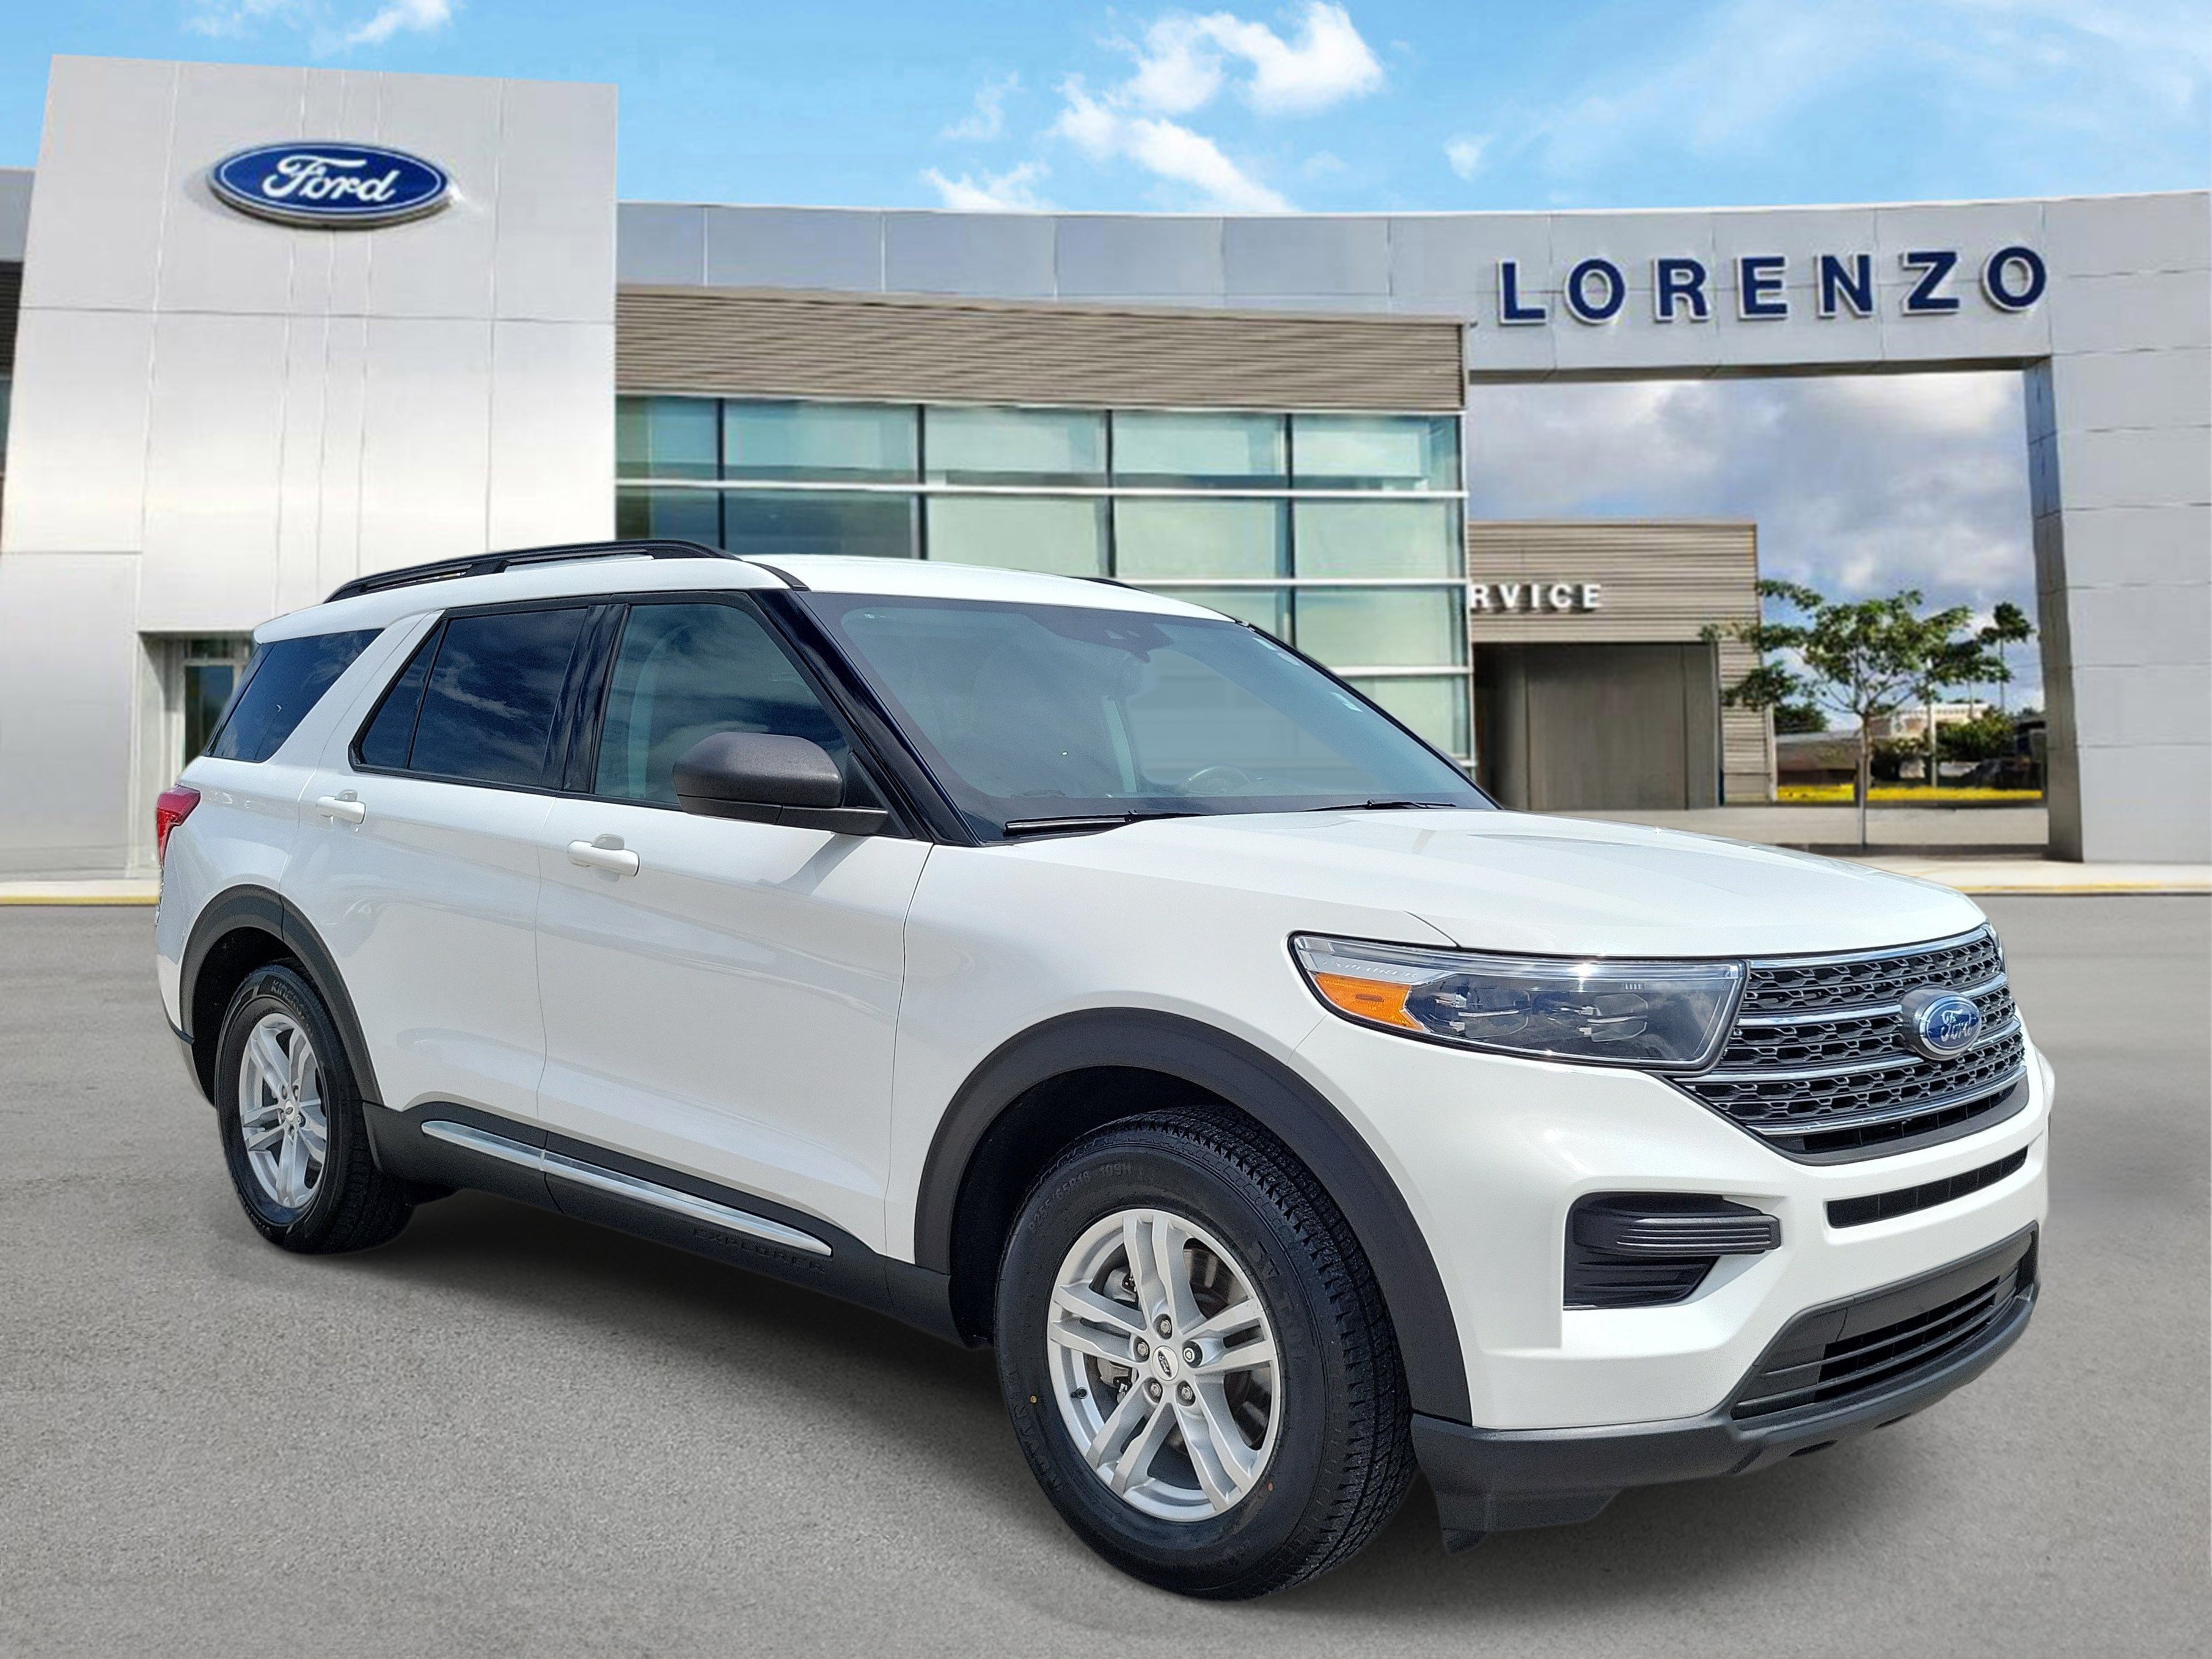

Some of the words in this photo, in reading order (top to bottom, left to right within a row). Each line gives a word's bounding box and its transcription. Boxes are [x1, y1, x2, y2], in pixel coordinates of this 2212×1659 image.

[262, 155, 401, 202] Ford
[1496, 245, 2048, 325] LORENZO
[1940, 1008, 1974, 1042] Ford
